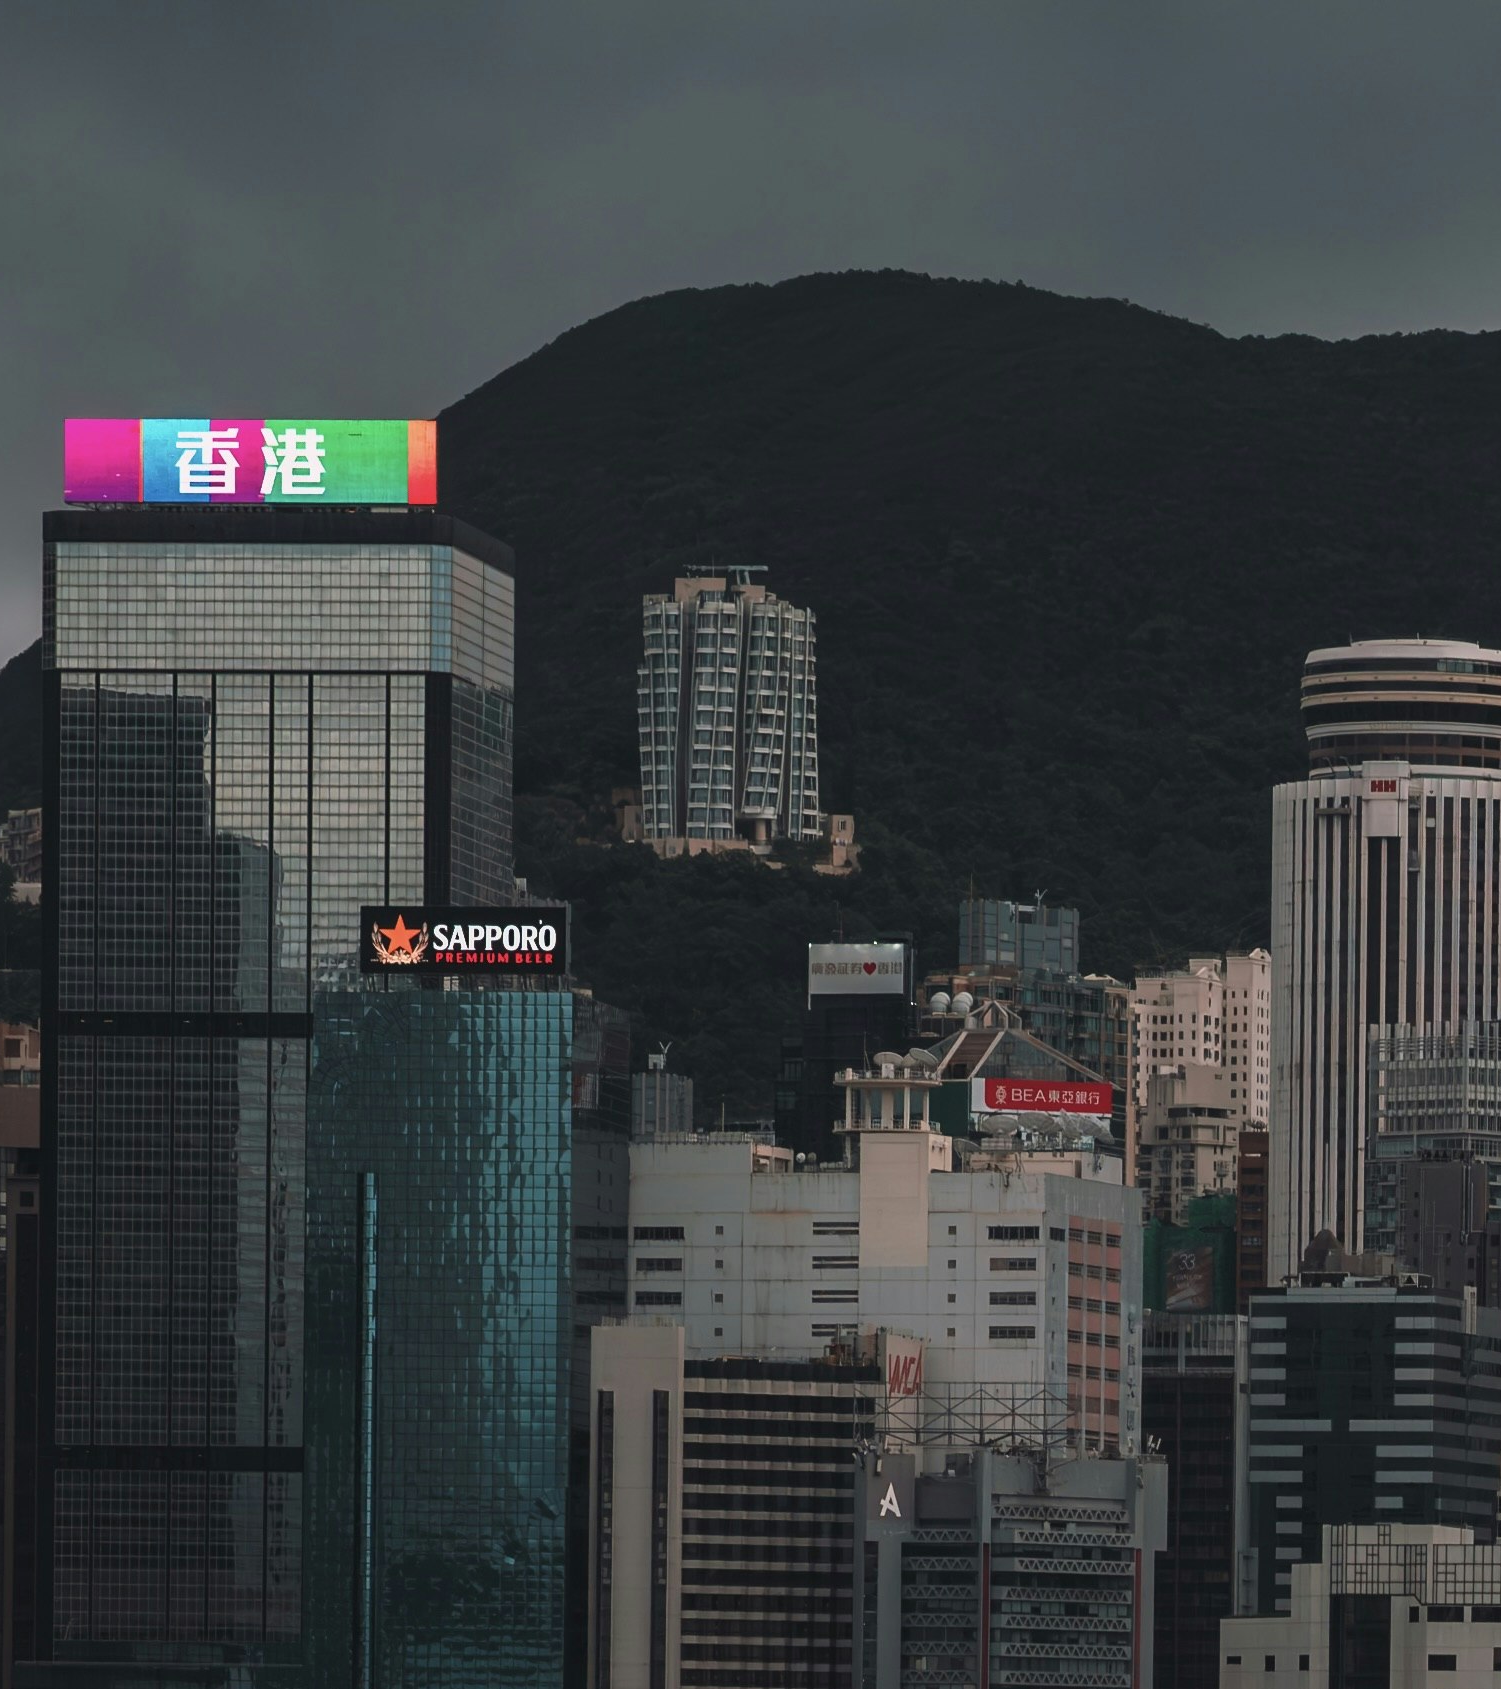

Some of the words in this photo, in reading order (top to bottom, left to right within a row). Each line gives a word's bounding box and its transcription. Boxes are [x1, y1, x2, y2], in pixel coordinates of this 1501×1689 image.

[175, 427, 327, 495] 香港
[432, 919, 557, 952] SAPPORO
[435, 951, 509, 964] PREMIUM
[515, 951, 555, 964] BEER
[1011, 1088, 1047, 1102] BEA
[1048, 1089, 1100, 1105] 東亞銀行
[880, 1482, 902, 1517] A
